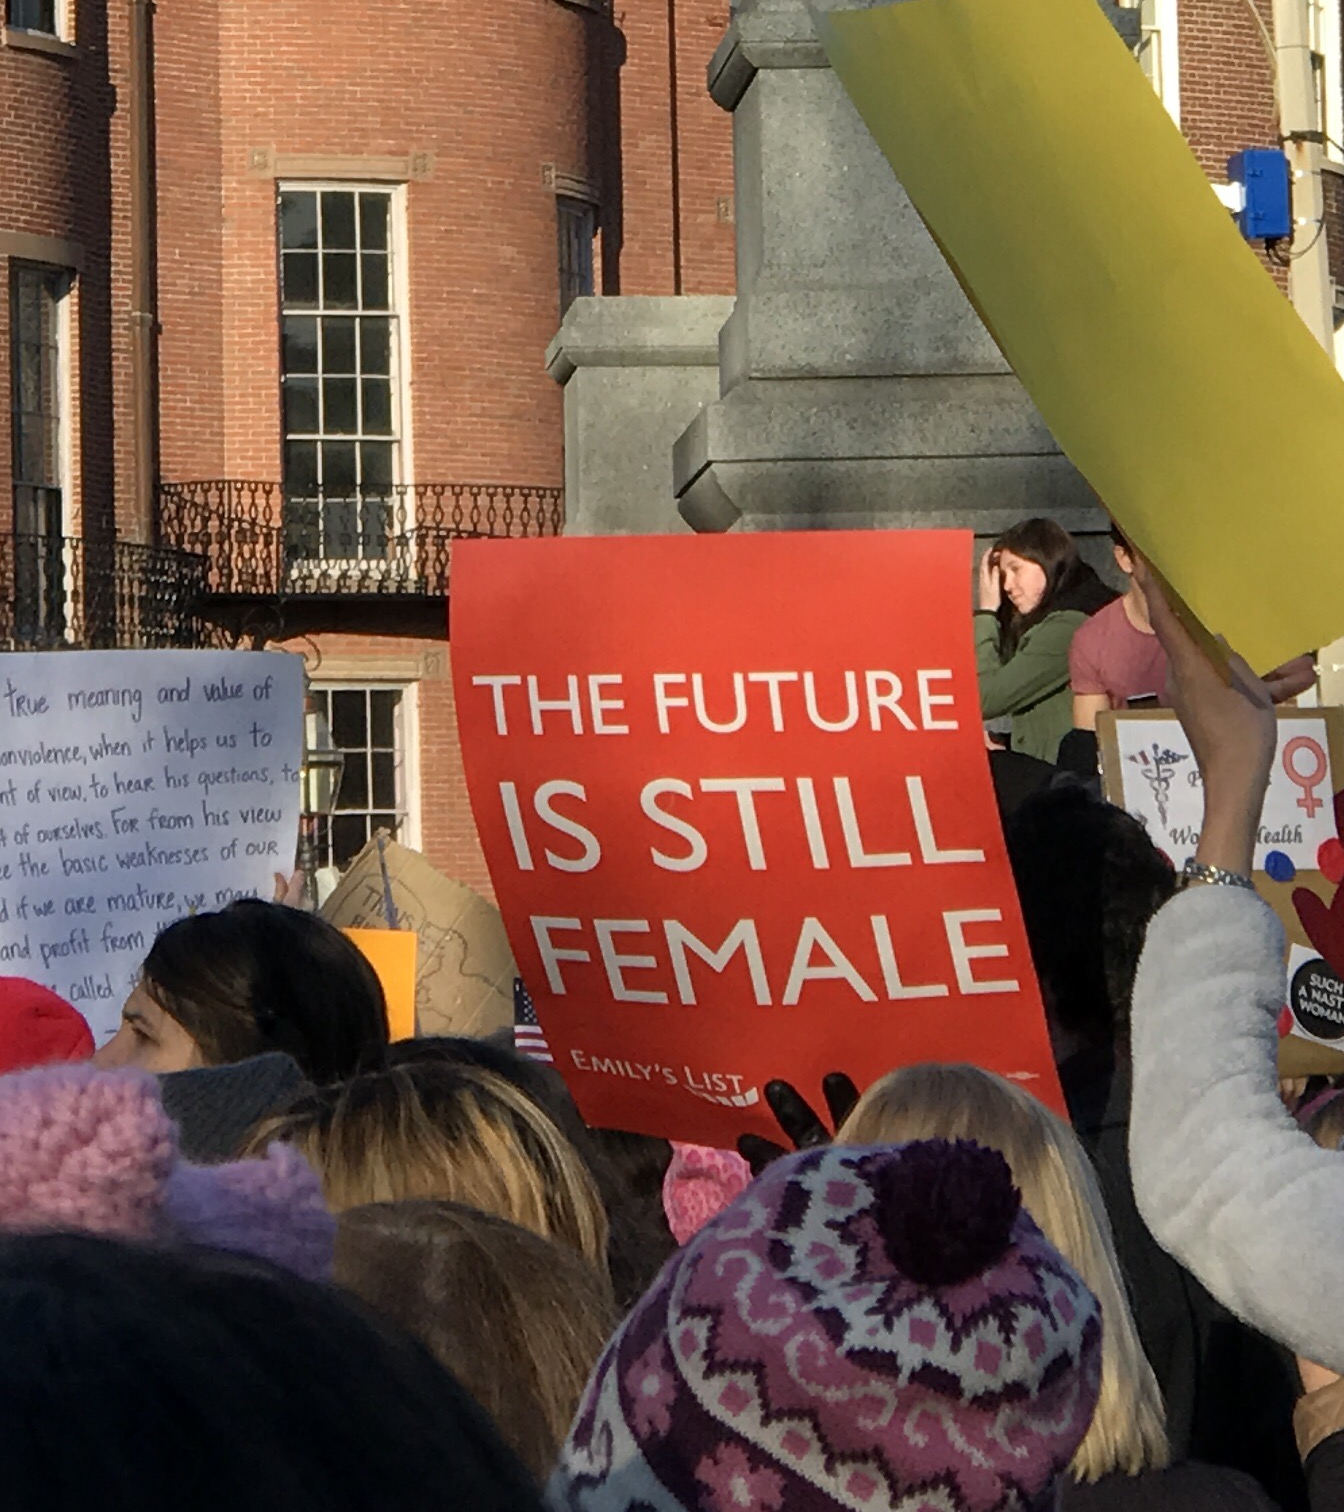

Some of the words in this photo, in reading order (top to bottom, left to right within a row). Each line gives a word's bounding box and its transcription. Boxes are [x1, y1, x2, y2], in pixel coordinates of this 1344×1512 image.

[67, 685, 143, 724] meaning
[157, 676, 191, 705] and
[203, 675, 244, 703] value
[252, 674, 275, 702] of
[472, 674, 631, 736] THE
[653, 668, 959, 734] FUTURE
[89, 732, 132, 762] when
[142, 729, 156, 754] it
[162, 725, 208, 759] helps
[215, 733, 238, 749] us
[248, 721, 273, 748] to
[26, 778, 42, 804] of
[90, 772, 109, 799] to
[163, 764, 190, 789] his
[197, 766, 275, 797] questions,
[281, 762, 300, 784] to
[13, 821, 30, 846] of
[201, 798, 230, 827] his
[238, 805, 283, 825] view
[500, 779, 602, 873] IS
[639, 775, 986, 872] STILL
[18, 851, 50, 878] the
[59, 846, 109, 877] basic
[115, 840, 210, 871] weaknesses
[219, 838, 239, 862] of
[16, 894, 29, 920] if
[32, 899, 56, 919] we
[183, 890, 207, 910] we
[0, 936, 32, 962] and
[529, 908, 1021, 1007] FEMALE
[69, 975, 115, 1003] called
[1298, 985, 1309, 998] A
[1309, 973, 1344, 995] SUCH
[570, 1048, 678, 1086] EMILY'S
[684, 1065, 744, 1095] LIST
